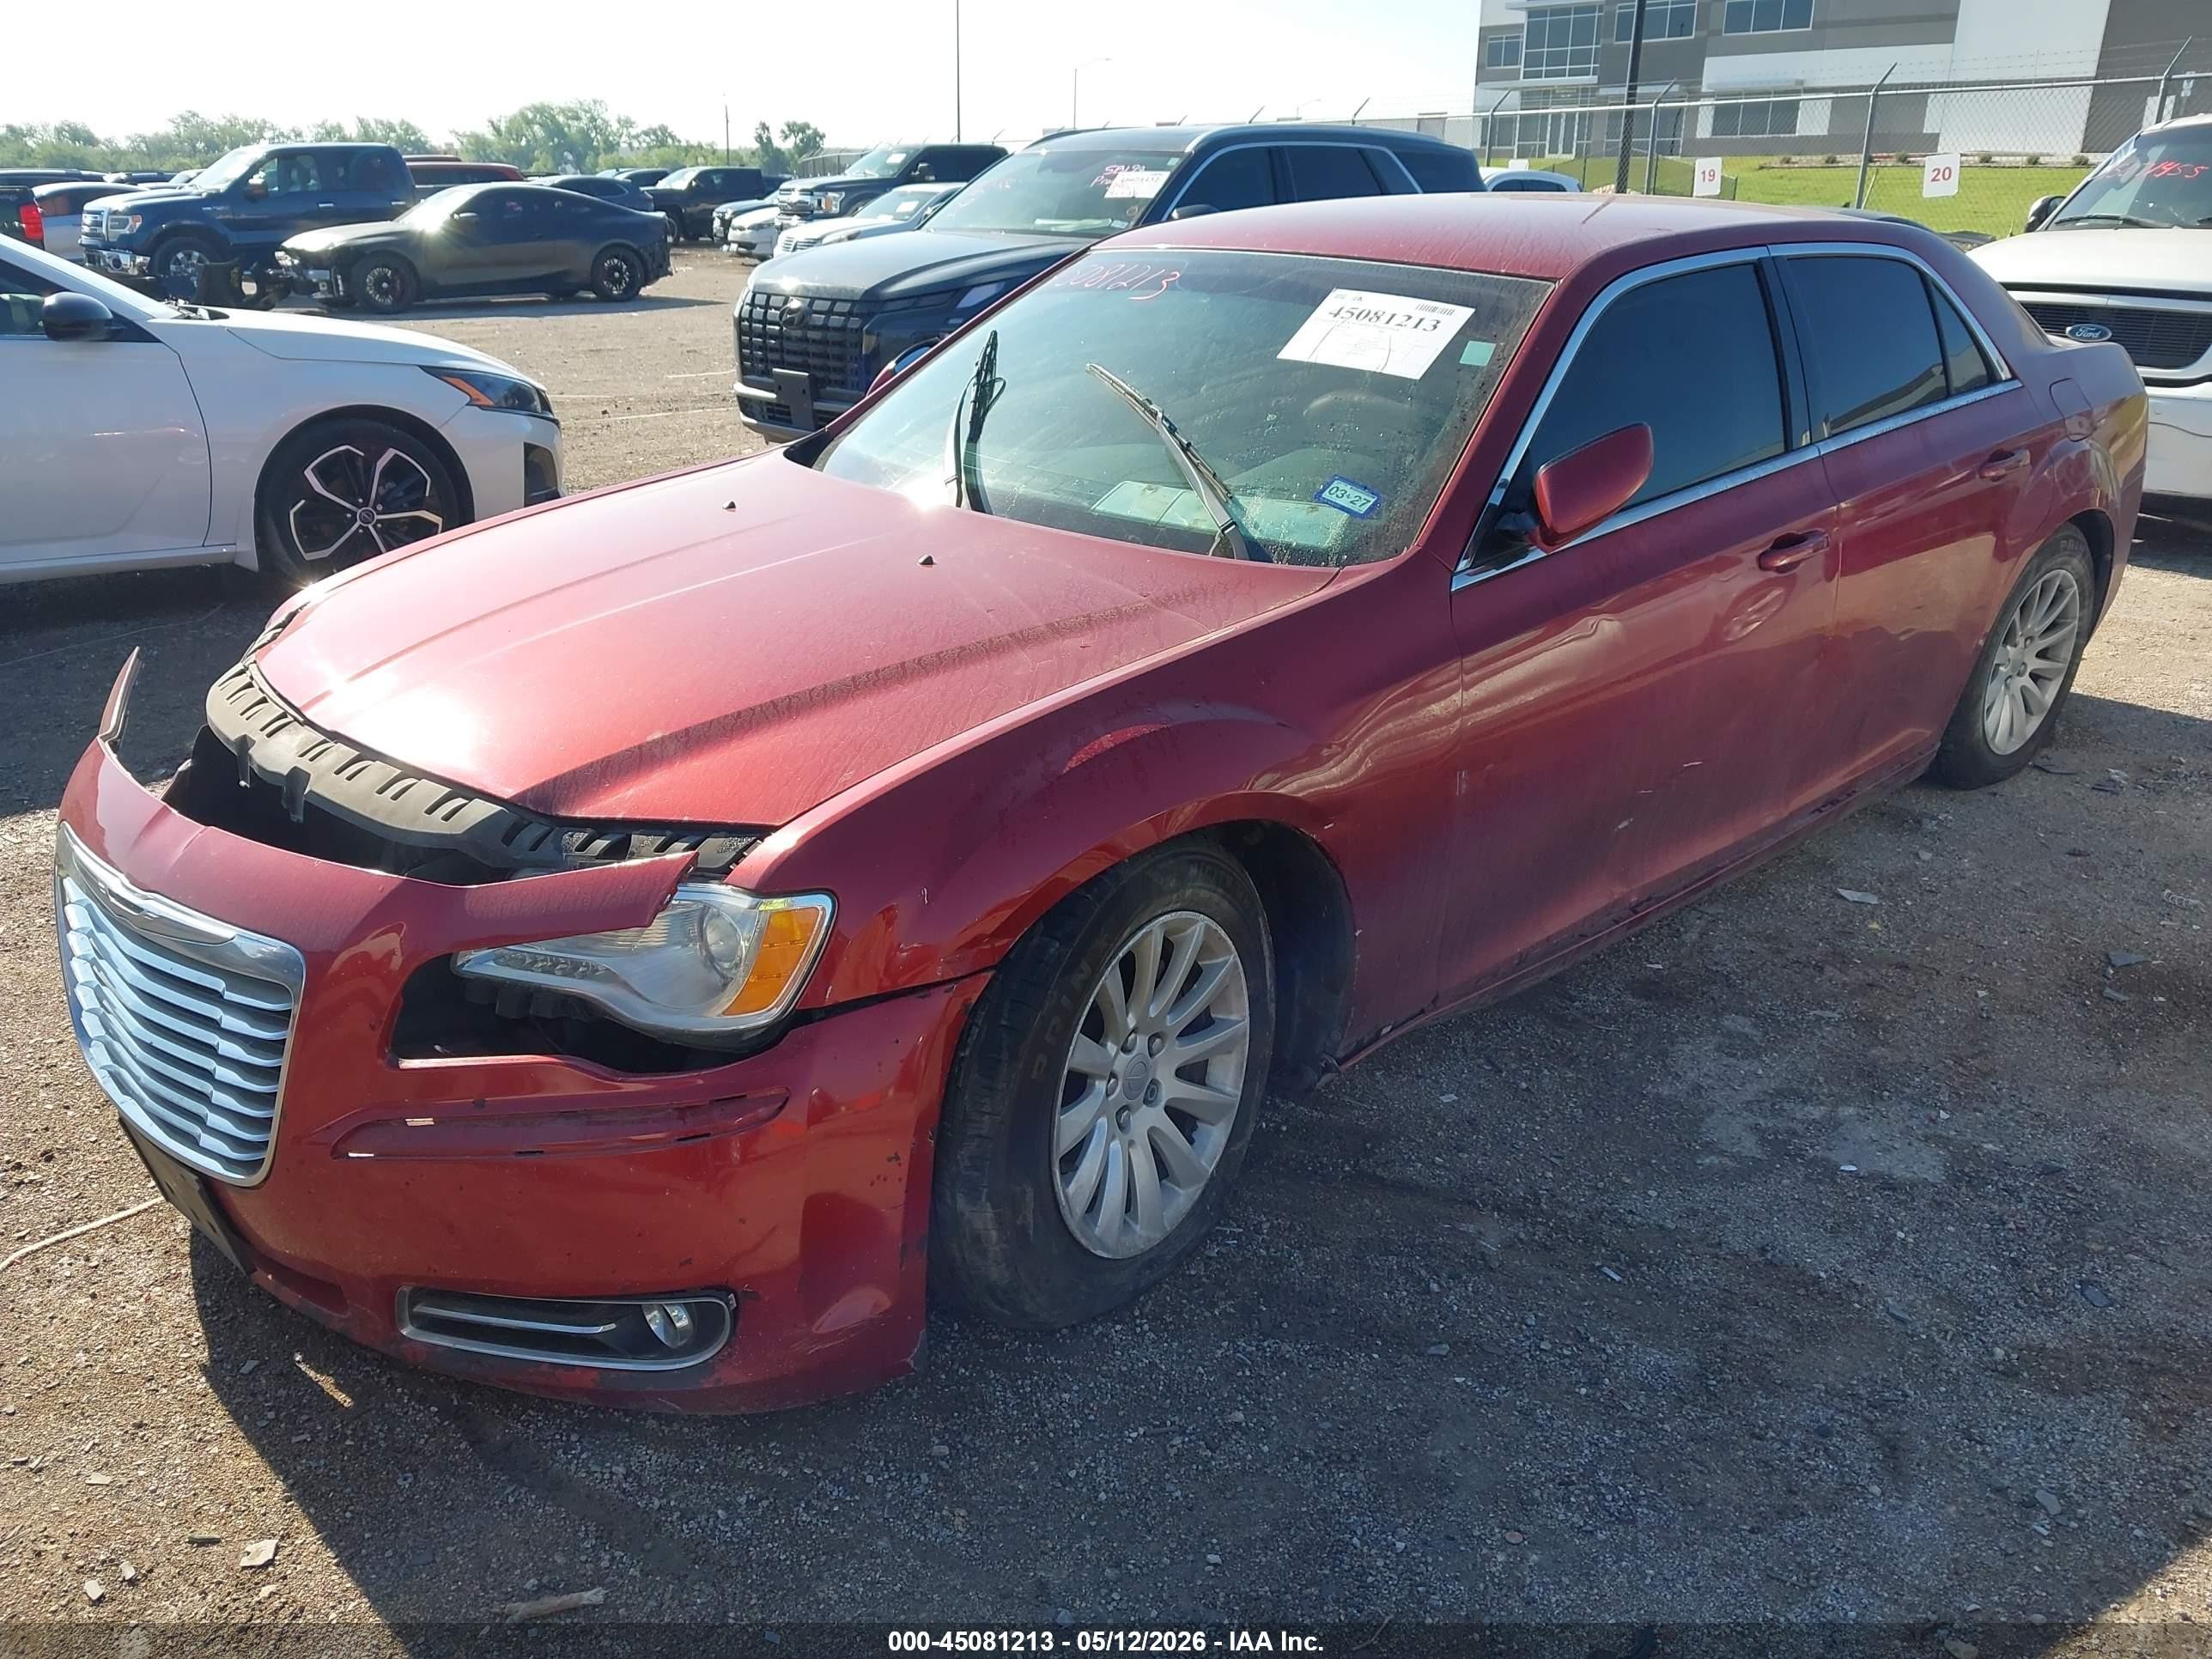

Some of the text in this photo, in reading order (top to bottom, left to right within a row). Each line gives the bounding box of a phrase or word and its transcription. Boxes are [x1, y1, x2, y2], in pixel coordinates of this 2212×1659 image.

[1701, 168, 1716, 183] 19
[1930, 167, 1952, 182] 20
[1328, 306, 1441, 332] 45081213
[2074, 326, 2102, 338] Ford
